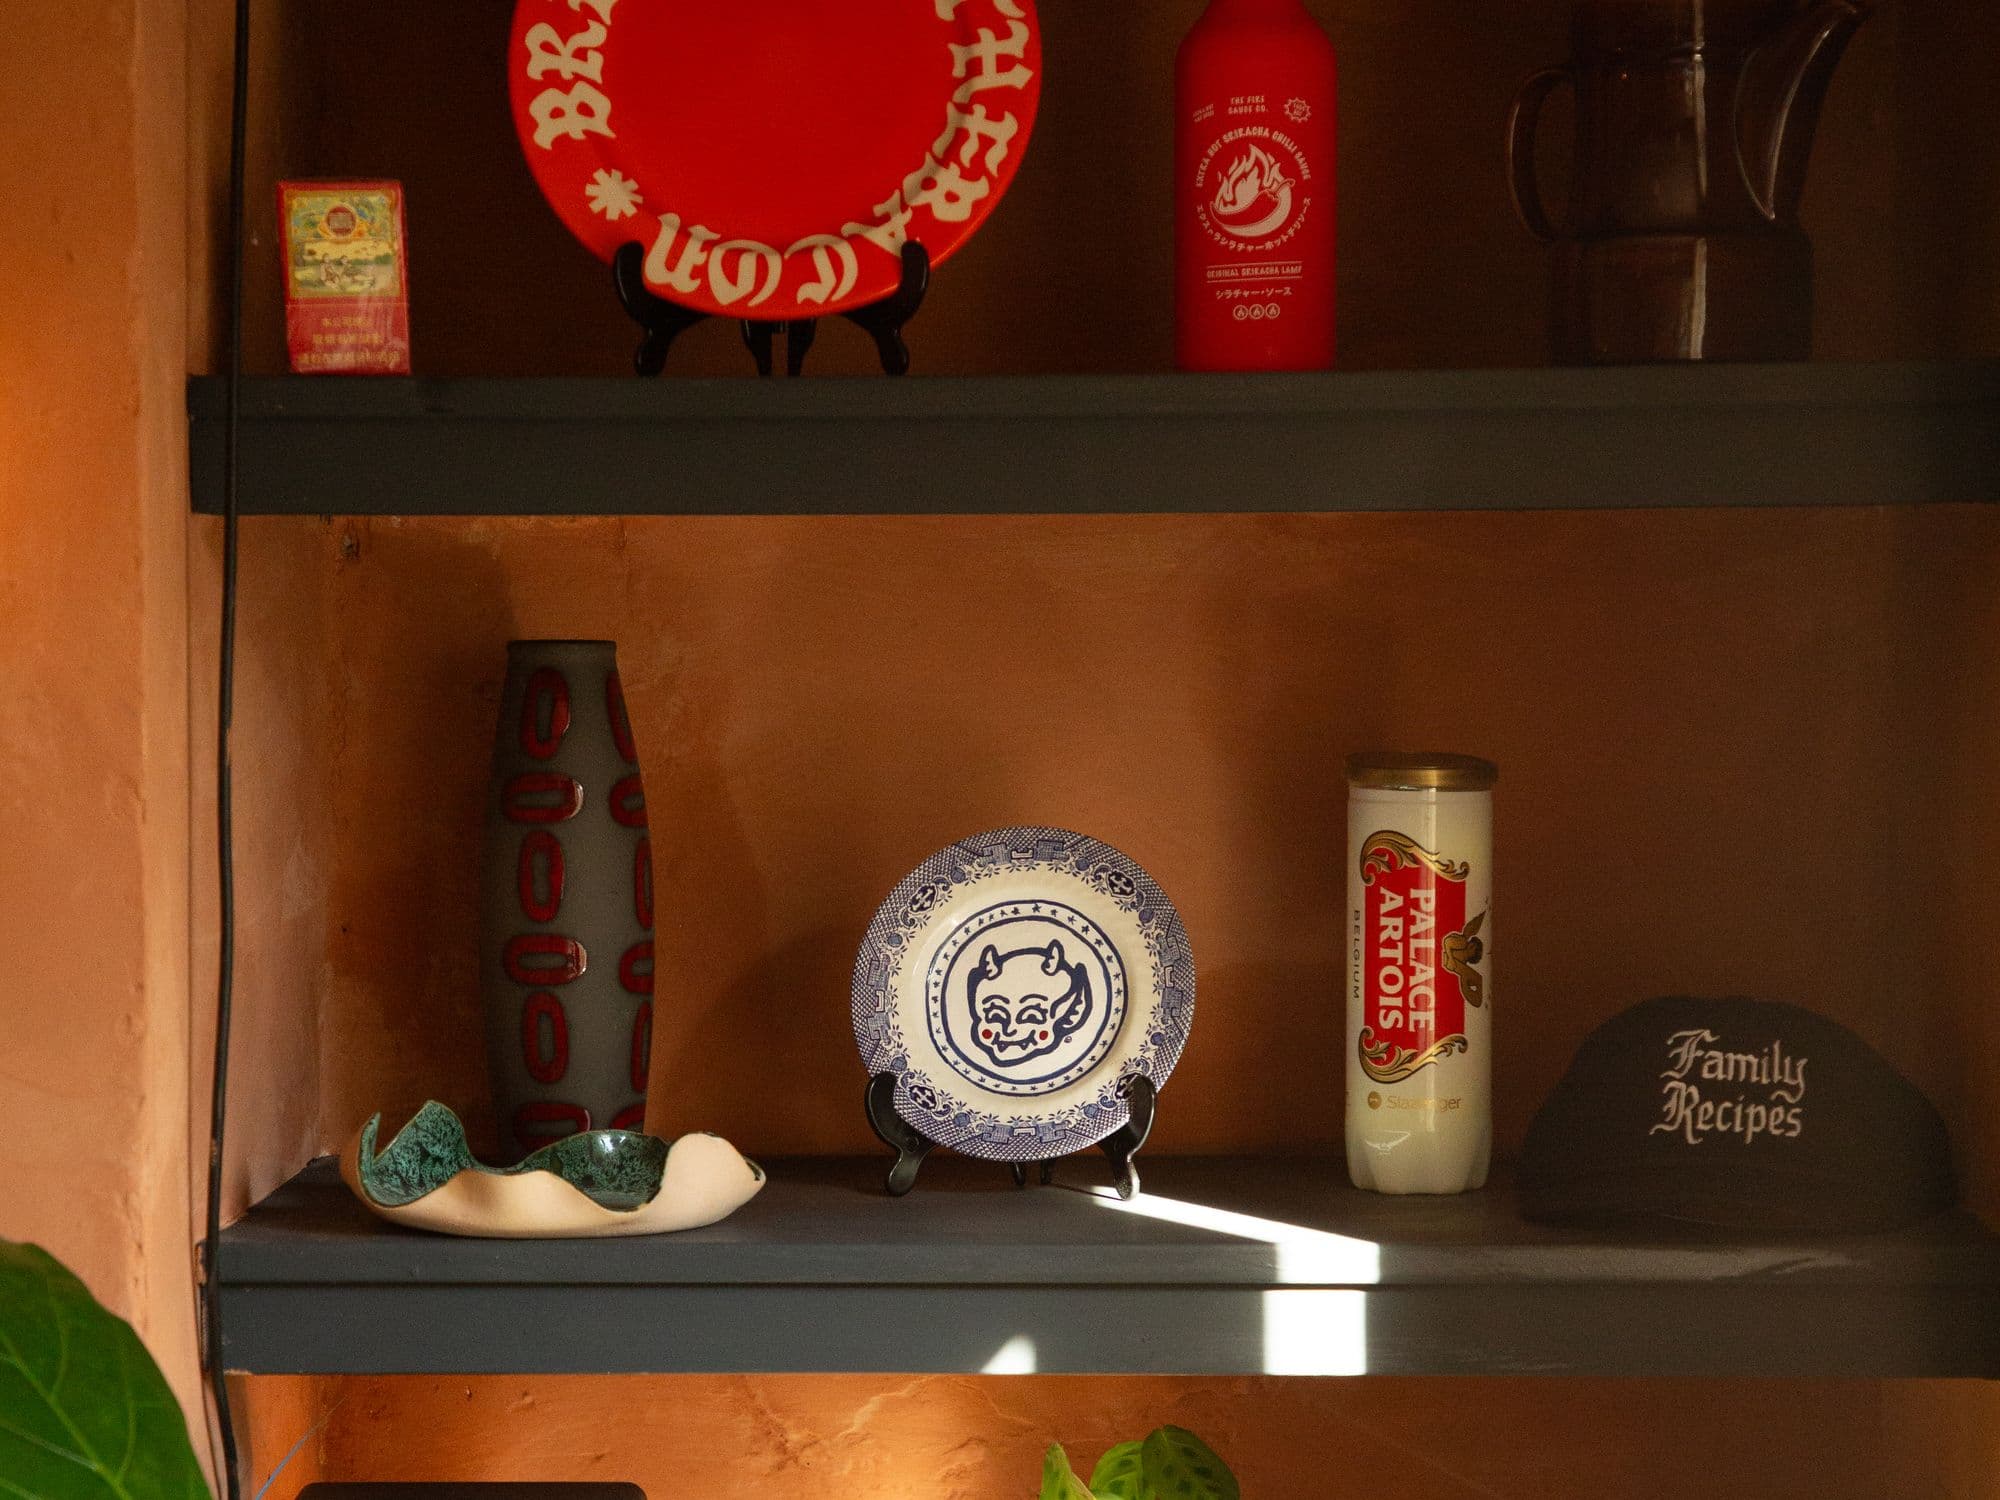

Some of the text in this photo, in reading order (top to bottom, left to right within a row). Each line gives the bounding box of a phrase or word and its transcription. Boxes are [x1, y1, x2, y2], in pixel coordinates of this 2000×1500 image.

[1196, 158, 1211, 187] EXTRA
[1207, 140, 1223, 157] HOT
[1223, 126, 1269, 143] SRIRACHA
[1294, 152, 1311, 179] SAUCE
[643, 152, 989, 307] BACON
[1353, 910, 1361, 998] BELGIUM
[1378, 887, 1404, 1029] ARTOIS
[1408, 888, 1436, 1032] PALACE
[1661, 1028, 1809, 1103] Family
[1649, 1081, 1804, 1145] Recipes
